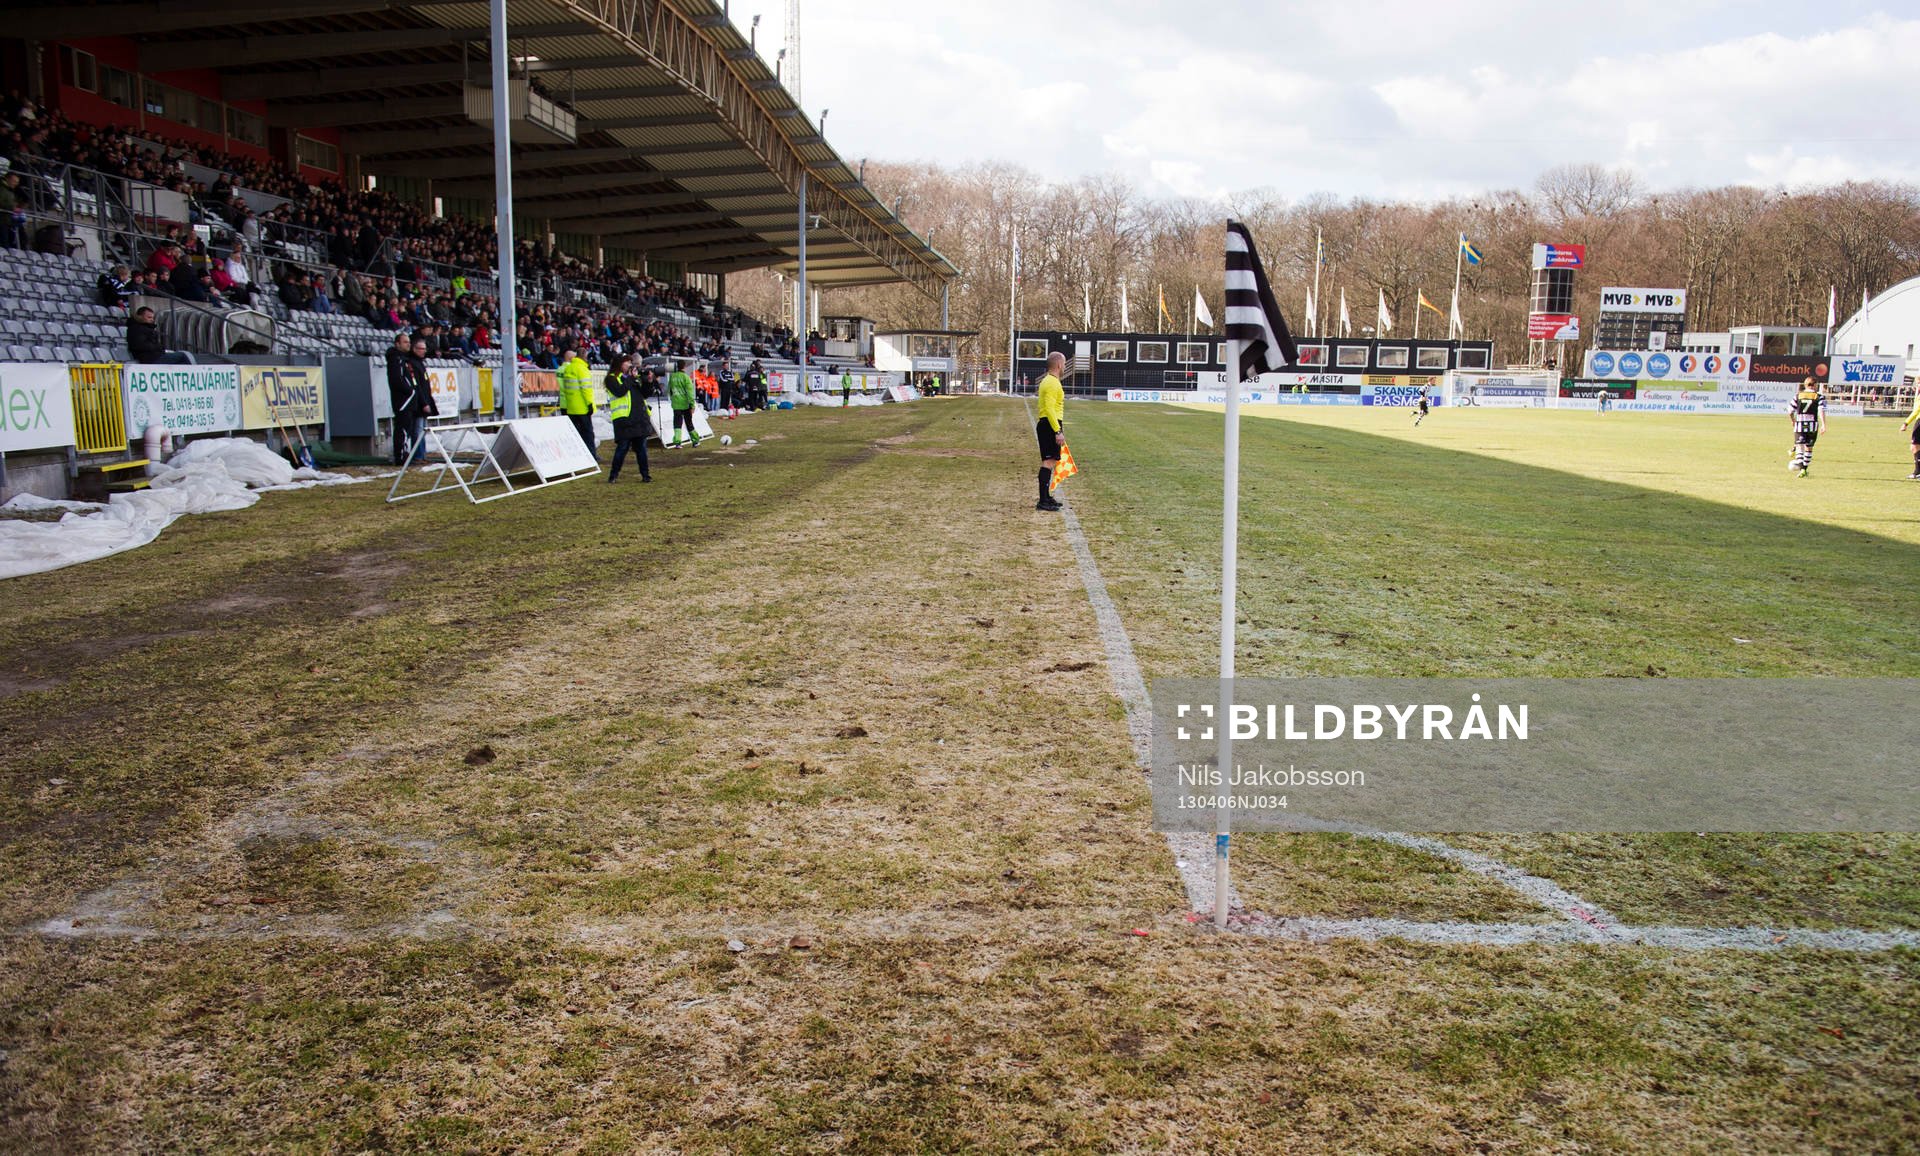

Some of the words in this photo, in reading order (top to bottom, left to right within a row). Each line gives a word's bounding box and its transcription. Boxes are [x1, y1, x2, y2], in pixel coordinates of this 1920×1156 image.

[1603, 294, 1632, 305] MVB
[1645, 295, 1674, 306] MVB
[1753, 363, 1810, 375] Swedbank
[130, 372, 148, 393] AB
[150, 368, 236, 392] CENTRALVÄRME
[1310, 376, 1344, 384] MASITA
[1861, 373, 1880, 382] TELE
[1881, 373, 1894, 382] AB
[1123, 391, 1150, 401] TIPS
[1161, 392, 1187, 402] ELIT
[1375, 386, 1421, 396] SKANSK
[1208, 394, 1250, 403] Nora
[1373, 395, 1434, 406] BASMeal
[162, 398, 176, 411] Tel.
[1801, 400, 1812, 413] 7
[162, 416, 175, 429] Fax
